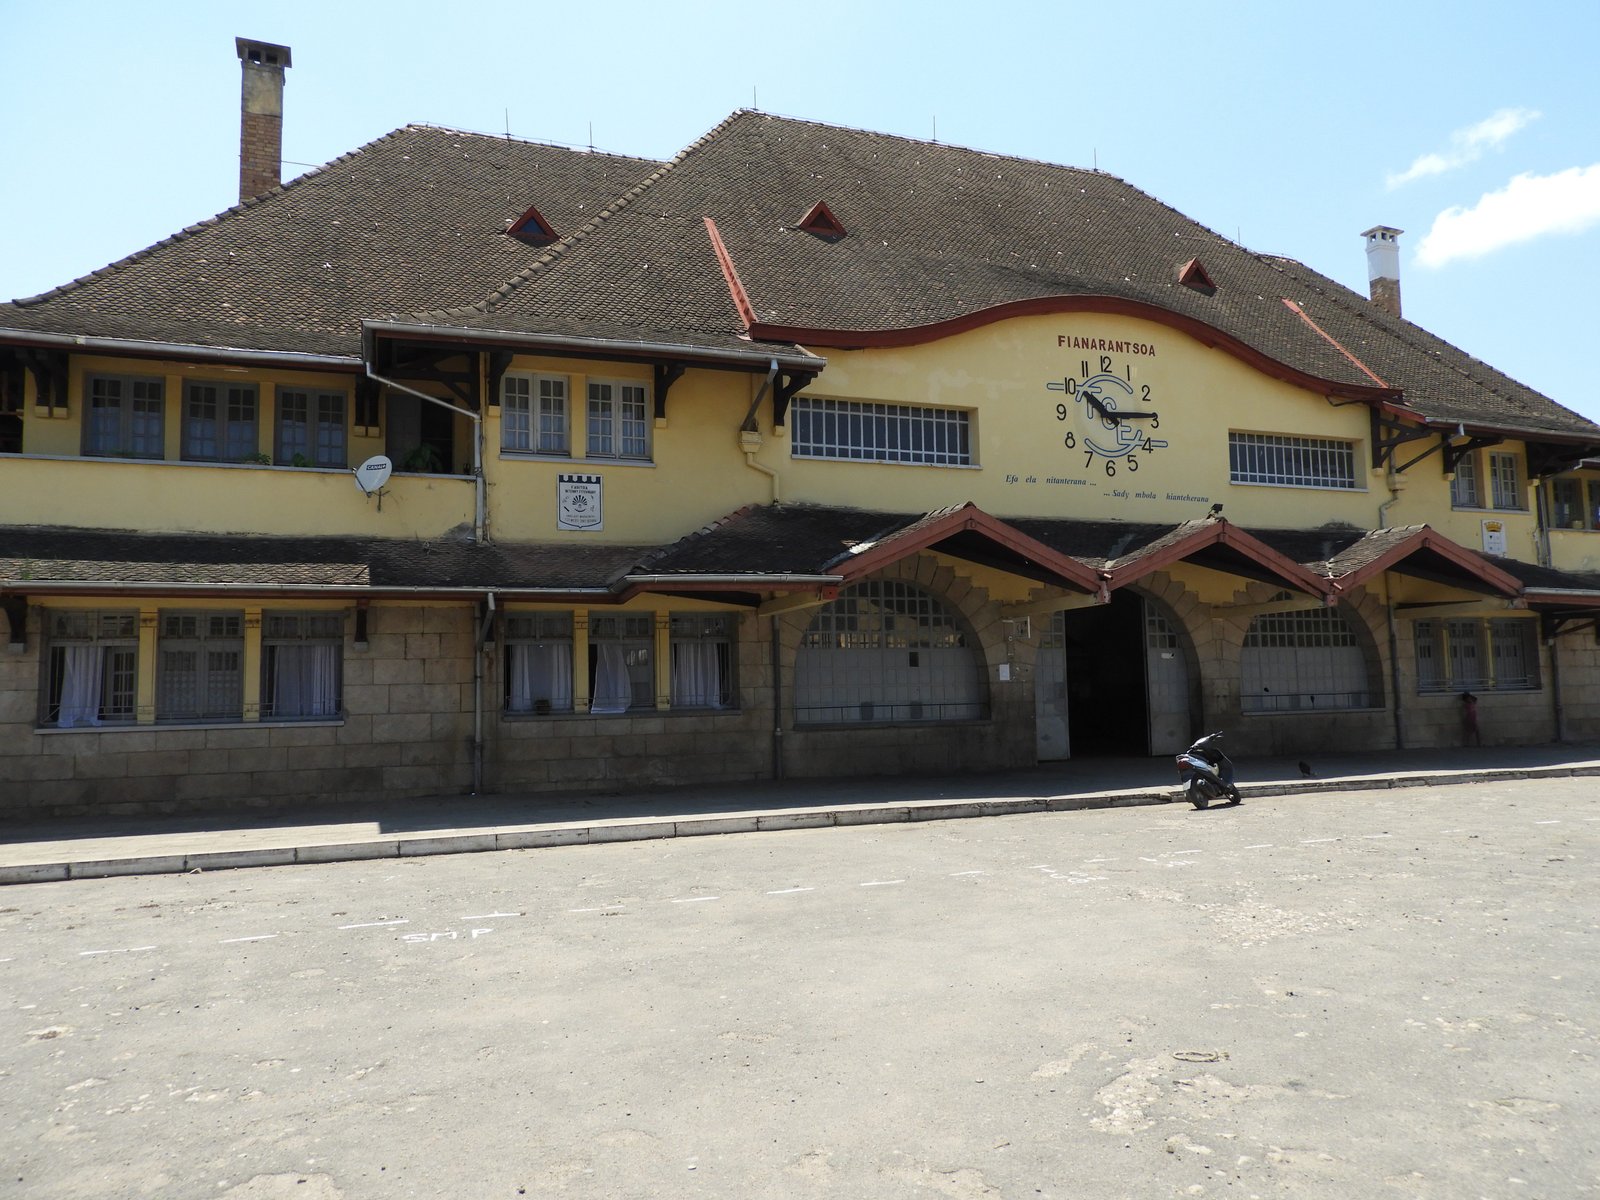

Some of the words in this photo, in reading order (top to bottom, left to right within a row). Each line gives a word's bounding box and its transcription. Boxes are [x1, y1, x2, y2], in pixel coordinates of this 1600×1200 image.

[1057, 334, 1156, 357] FIANARANTSOA
[1081, 360, 1089, 378] 11
[1100, 355, 1113, 373] 12
[1126, 364, 1131, 381] 1
[1064, 377, 1076, 395] 10
[1141, 384, 1151, 402] 2
[1056, 403, 1067, 421] 9
[1150, 412, 1159, 429] 3
[1064, 431, 1076, 449] 8
[1141, 437, 1154, 454] 4
[1083, 450, 1094, 468] 7
[1105, 459, 1116, 477] 6
[1127, 454, 1139, 472] 5
